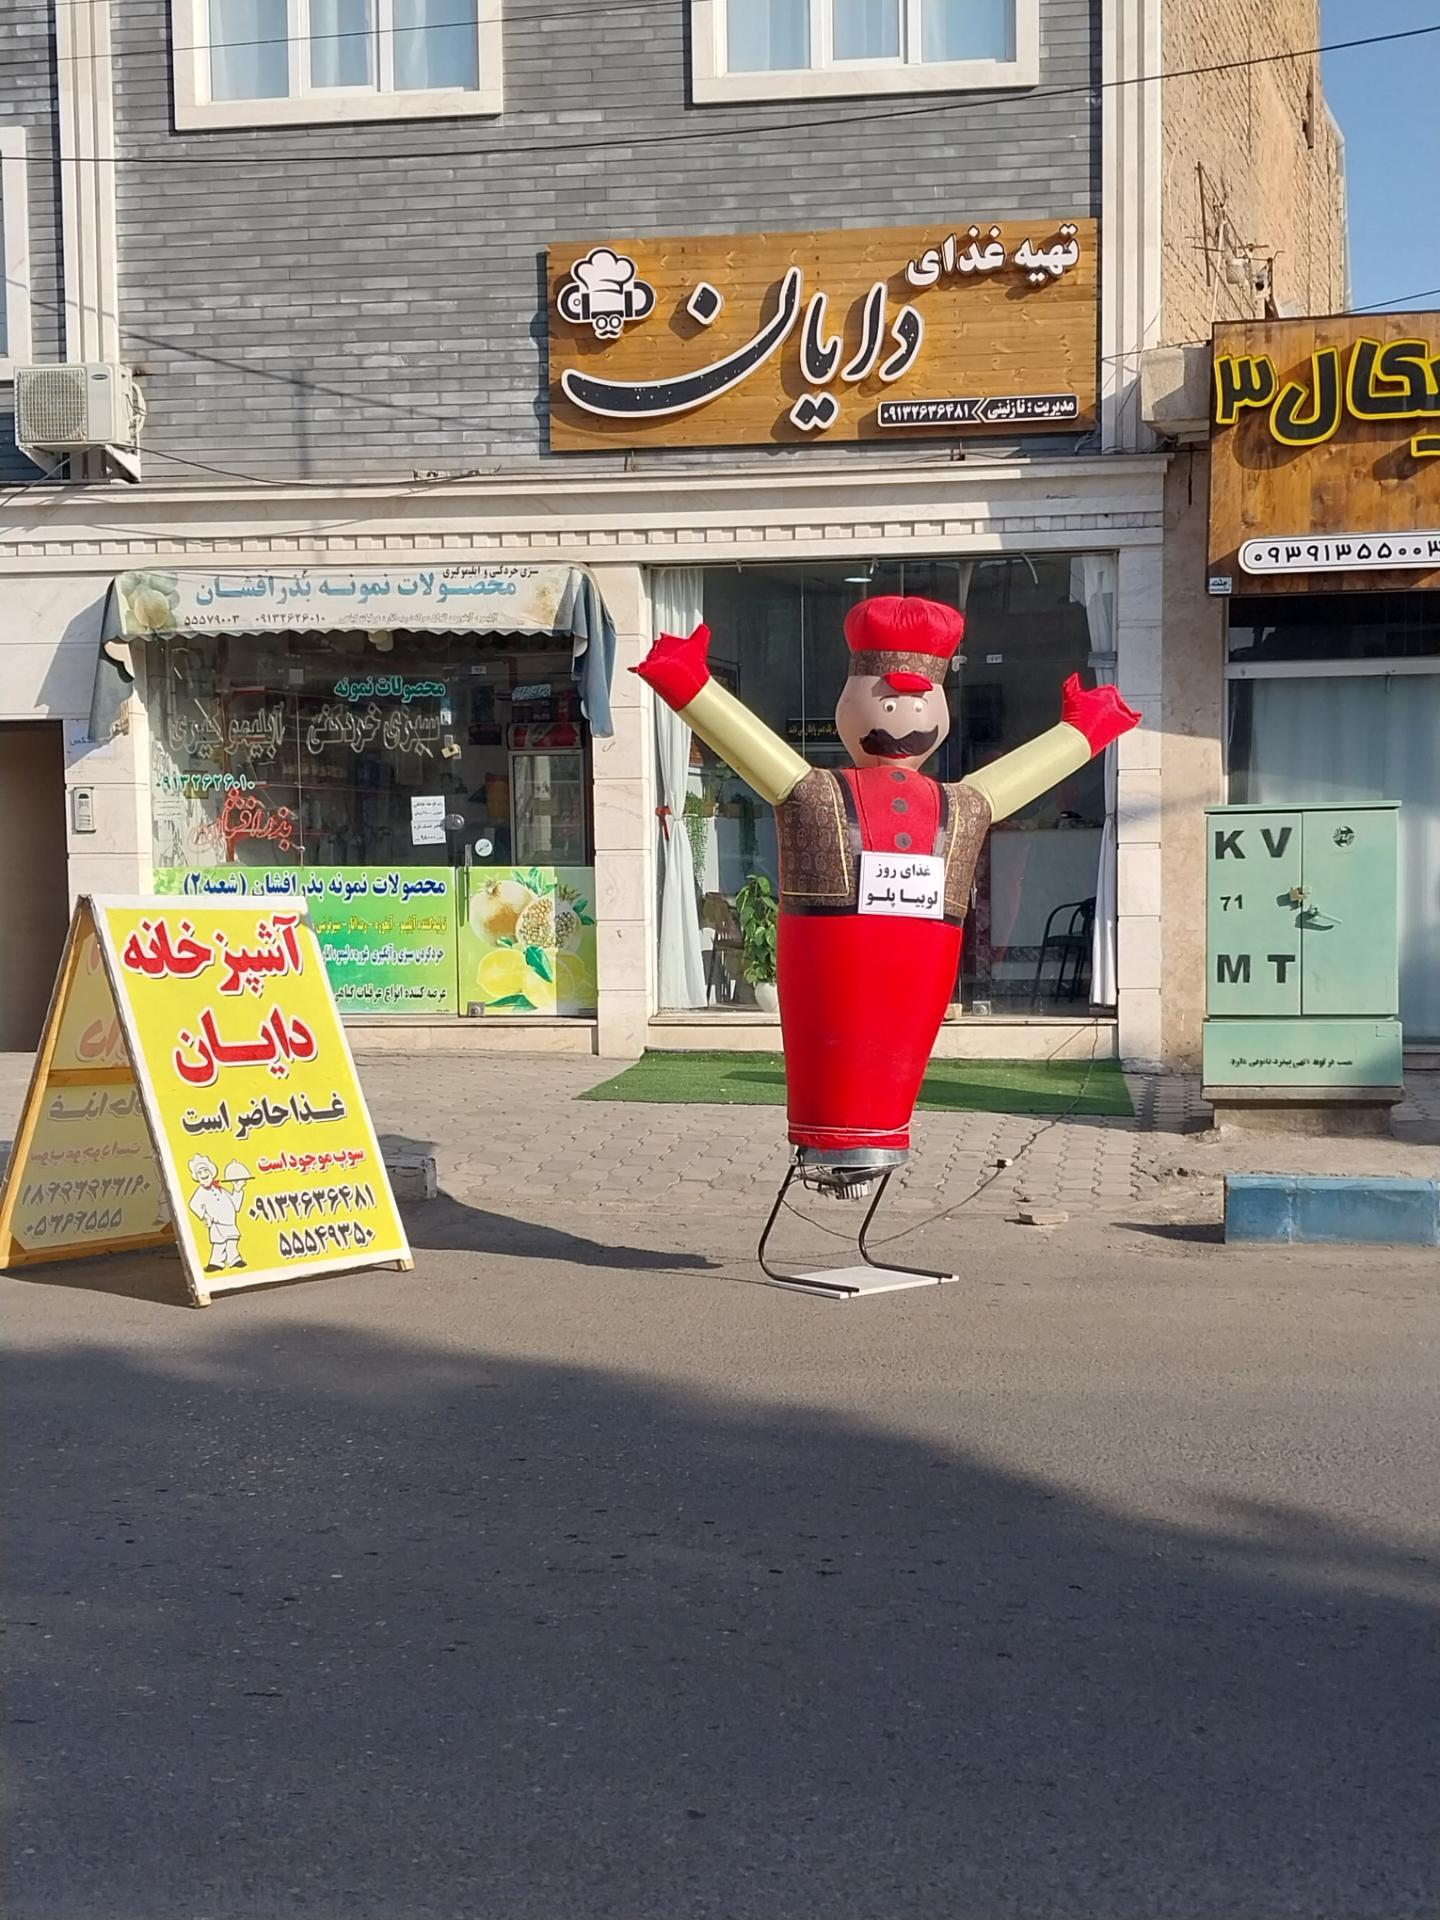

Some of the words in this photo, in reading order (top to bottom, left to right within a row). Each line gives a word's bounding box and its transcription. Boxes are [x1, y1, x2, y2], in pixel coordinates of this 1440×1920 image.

[907, 224, 1004, 288] غذای
[1014, 224, 1080, 288] تهیه
[561, 266, 924, 431] دایان
[1214, 353, 1278, 424] ۳
[318, 574, 391, 604] نمونه
[397, 572, 517, 604] محصولات
[334, 676, 375, 703] نمونه
[375, 675, 446, 704] محصولات
[875, 863, 897, 879] روز
[900, 863, 931, 879] غذای
[329, 872, 368, 901] نمونه
[372, 873, 446, 901] محصولات
[865, 887, 896, 908] پلو
[900, 888, 938, 909] لوبیا
[1219, 894, 1244, 912] 71
[175, 1007, 315, 1084] دایان
[182, 1101, 230, 1134] است
[235, 1096, 289, 1138] حاضر
[289, 1092, 346, 1122] غذا
[258, 1151, 288, 1172] است
[249, 1183, 375, 1221] ۰۹۱۳۲۶۳۶۴۸۱
[279, 1220, 374, 1257] ۵۵۵۴۹۳۵۰
